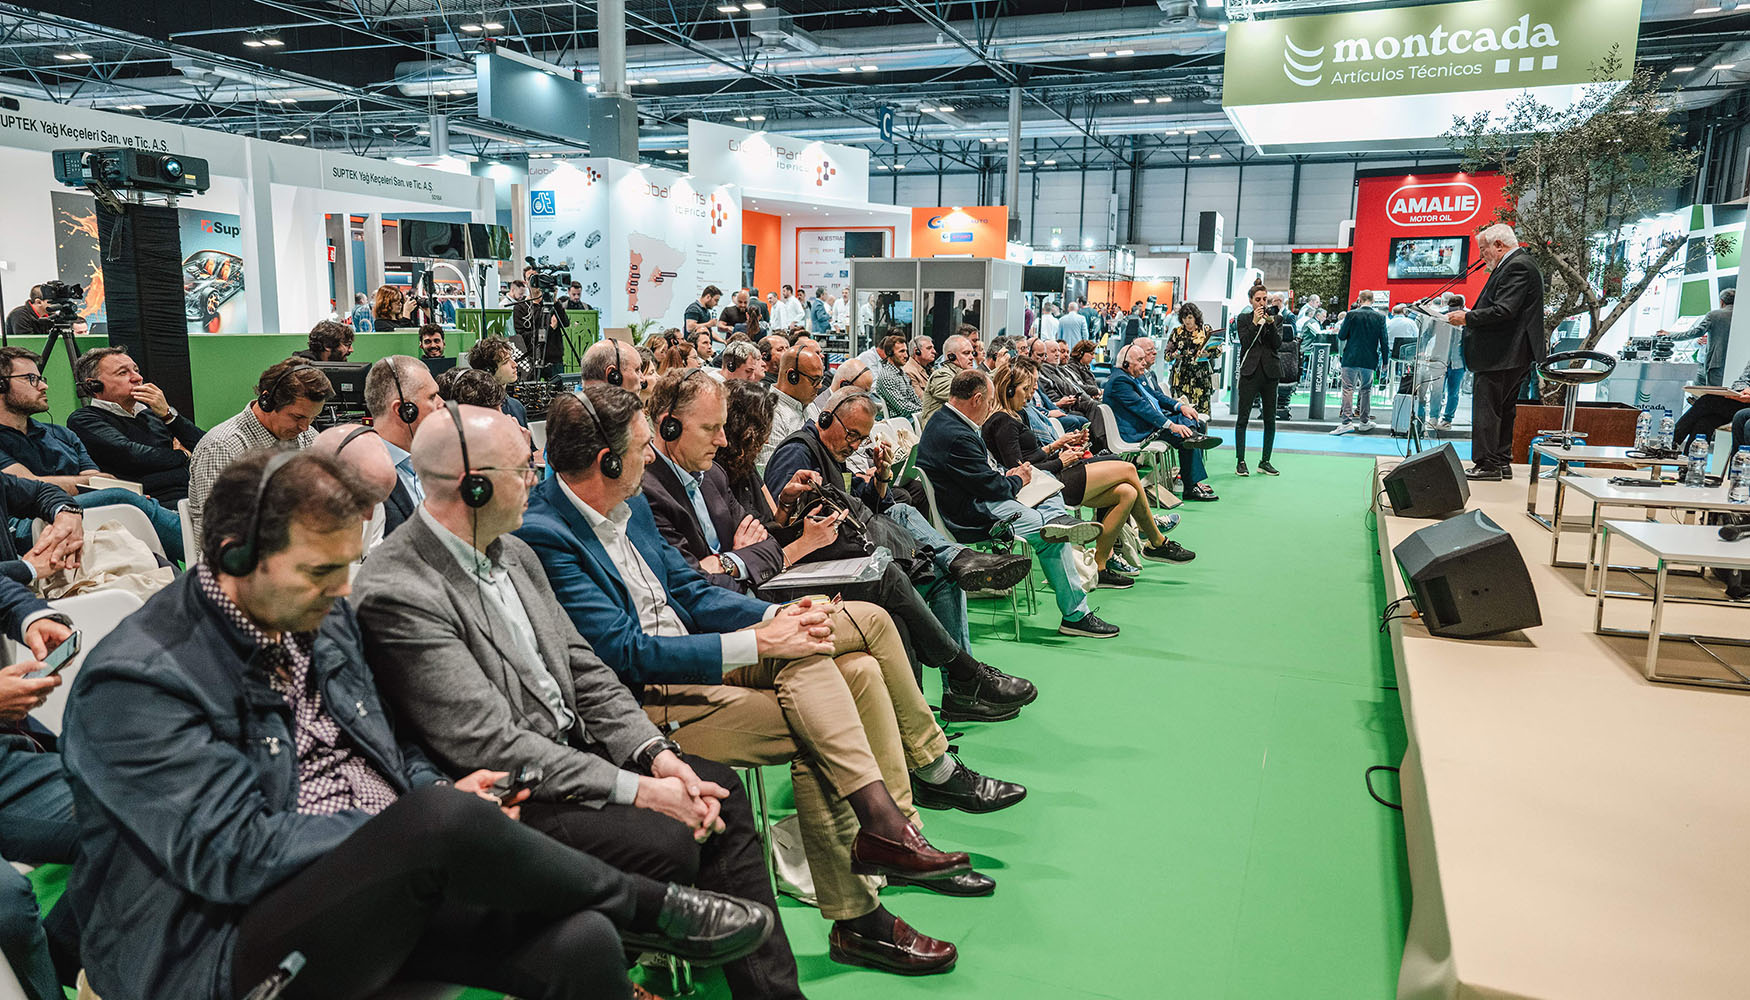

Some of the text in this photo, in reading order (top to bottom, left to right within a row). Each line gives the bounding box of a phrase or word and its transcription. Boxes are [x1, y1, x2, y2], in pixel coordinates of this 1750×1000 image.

[1332, 13, 1560, 63] montcada
[1331, 62, 1483, 85] Artículos Técnicos
[0, 113, 38, 132] UPTEK
[40, 119, 59, 138] Yağ
[60, 123, 100, 142] Keçeleri
[100, 130, 122, 145] San.
[122, 135, 133, 147] ve
[134, 135, 151, 149] Tic.
[883, 112, 891, 138] C
[332, 166, 358, 180] SUPTEK
[1391, 195, 1476, 214] AMALIE
[213, 221, 241, 238] Sup
[1409, 214, 1452, 223] MOTOR OIL
[1315, 348, 1325, 393] MECANIC PRO
